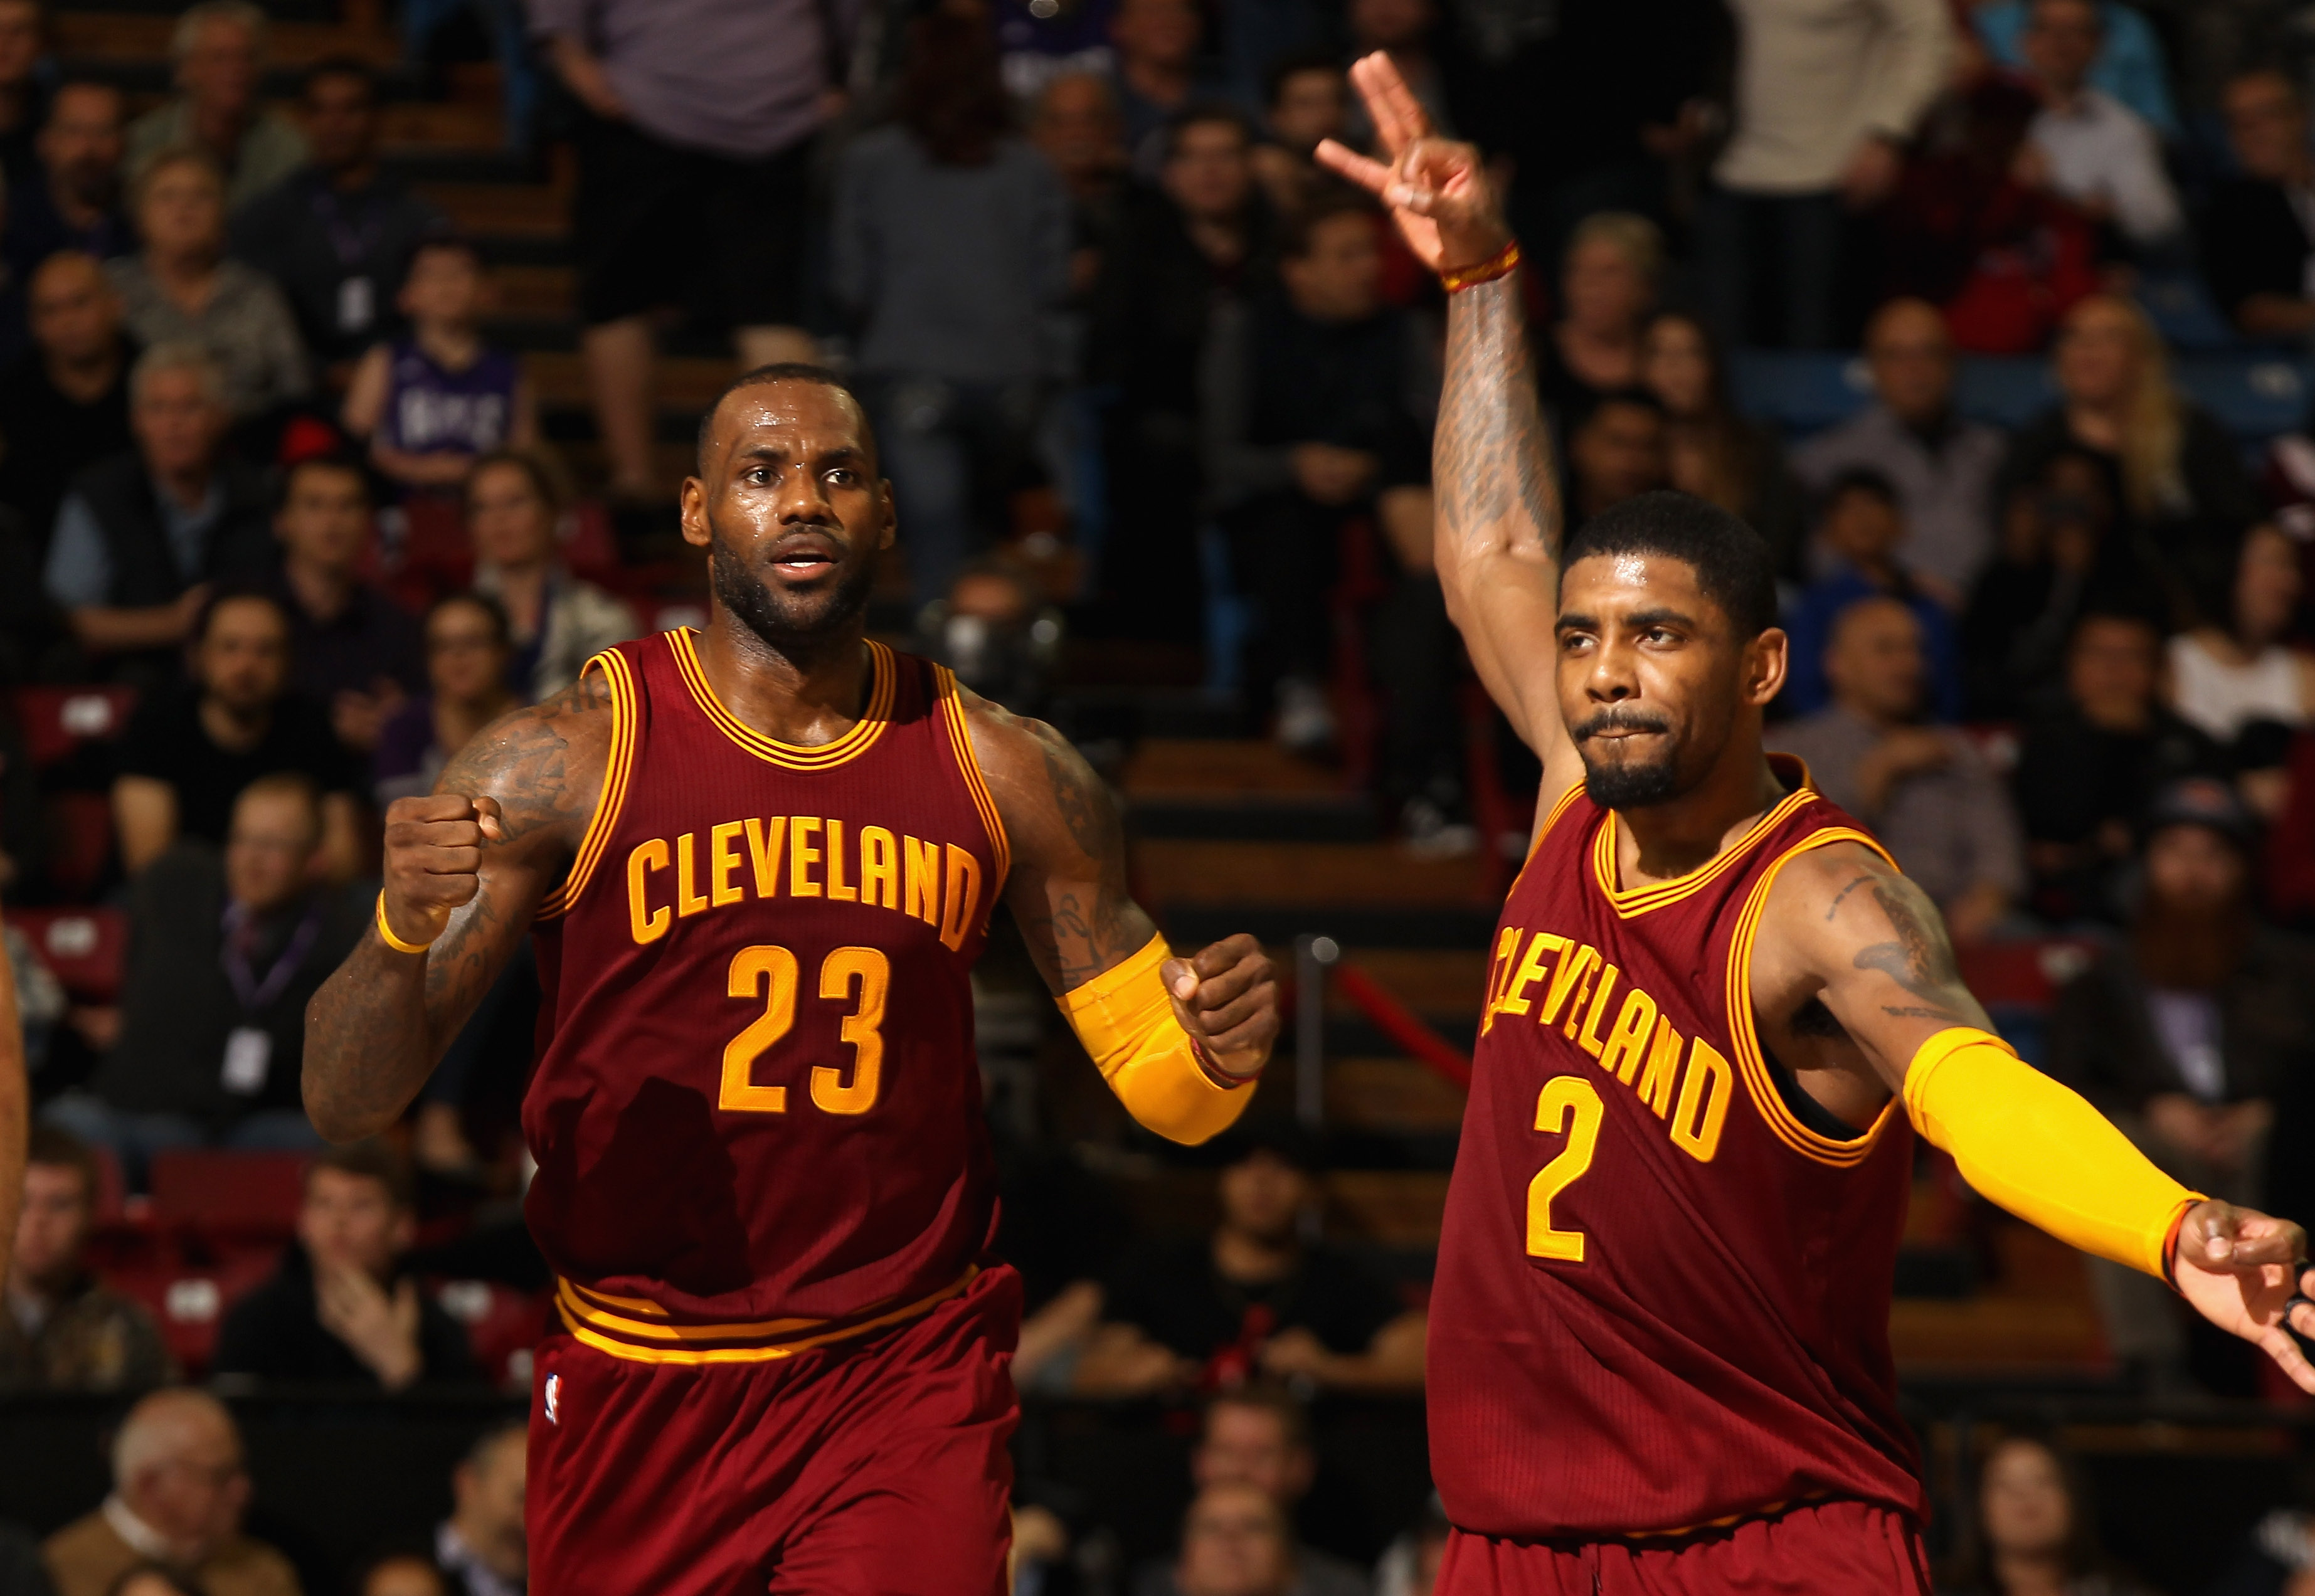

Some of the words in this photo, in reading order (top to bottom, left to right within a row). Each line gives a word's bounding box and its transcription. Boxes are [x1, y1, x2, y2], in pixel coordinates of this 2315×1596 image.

[627, 815, 981, 951] CLEVELAND
[718, 944, 891, 1116] 23
[1526, 1075, 1605, 1263] 2
